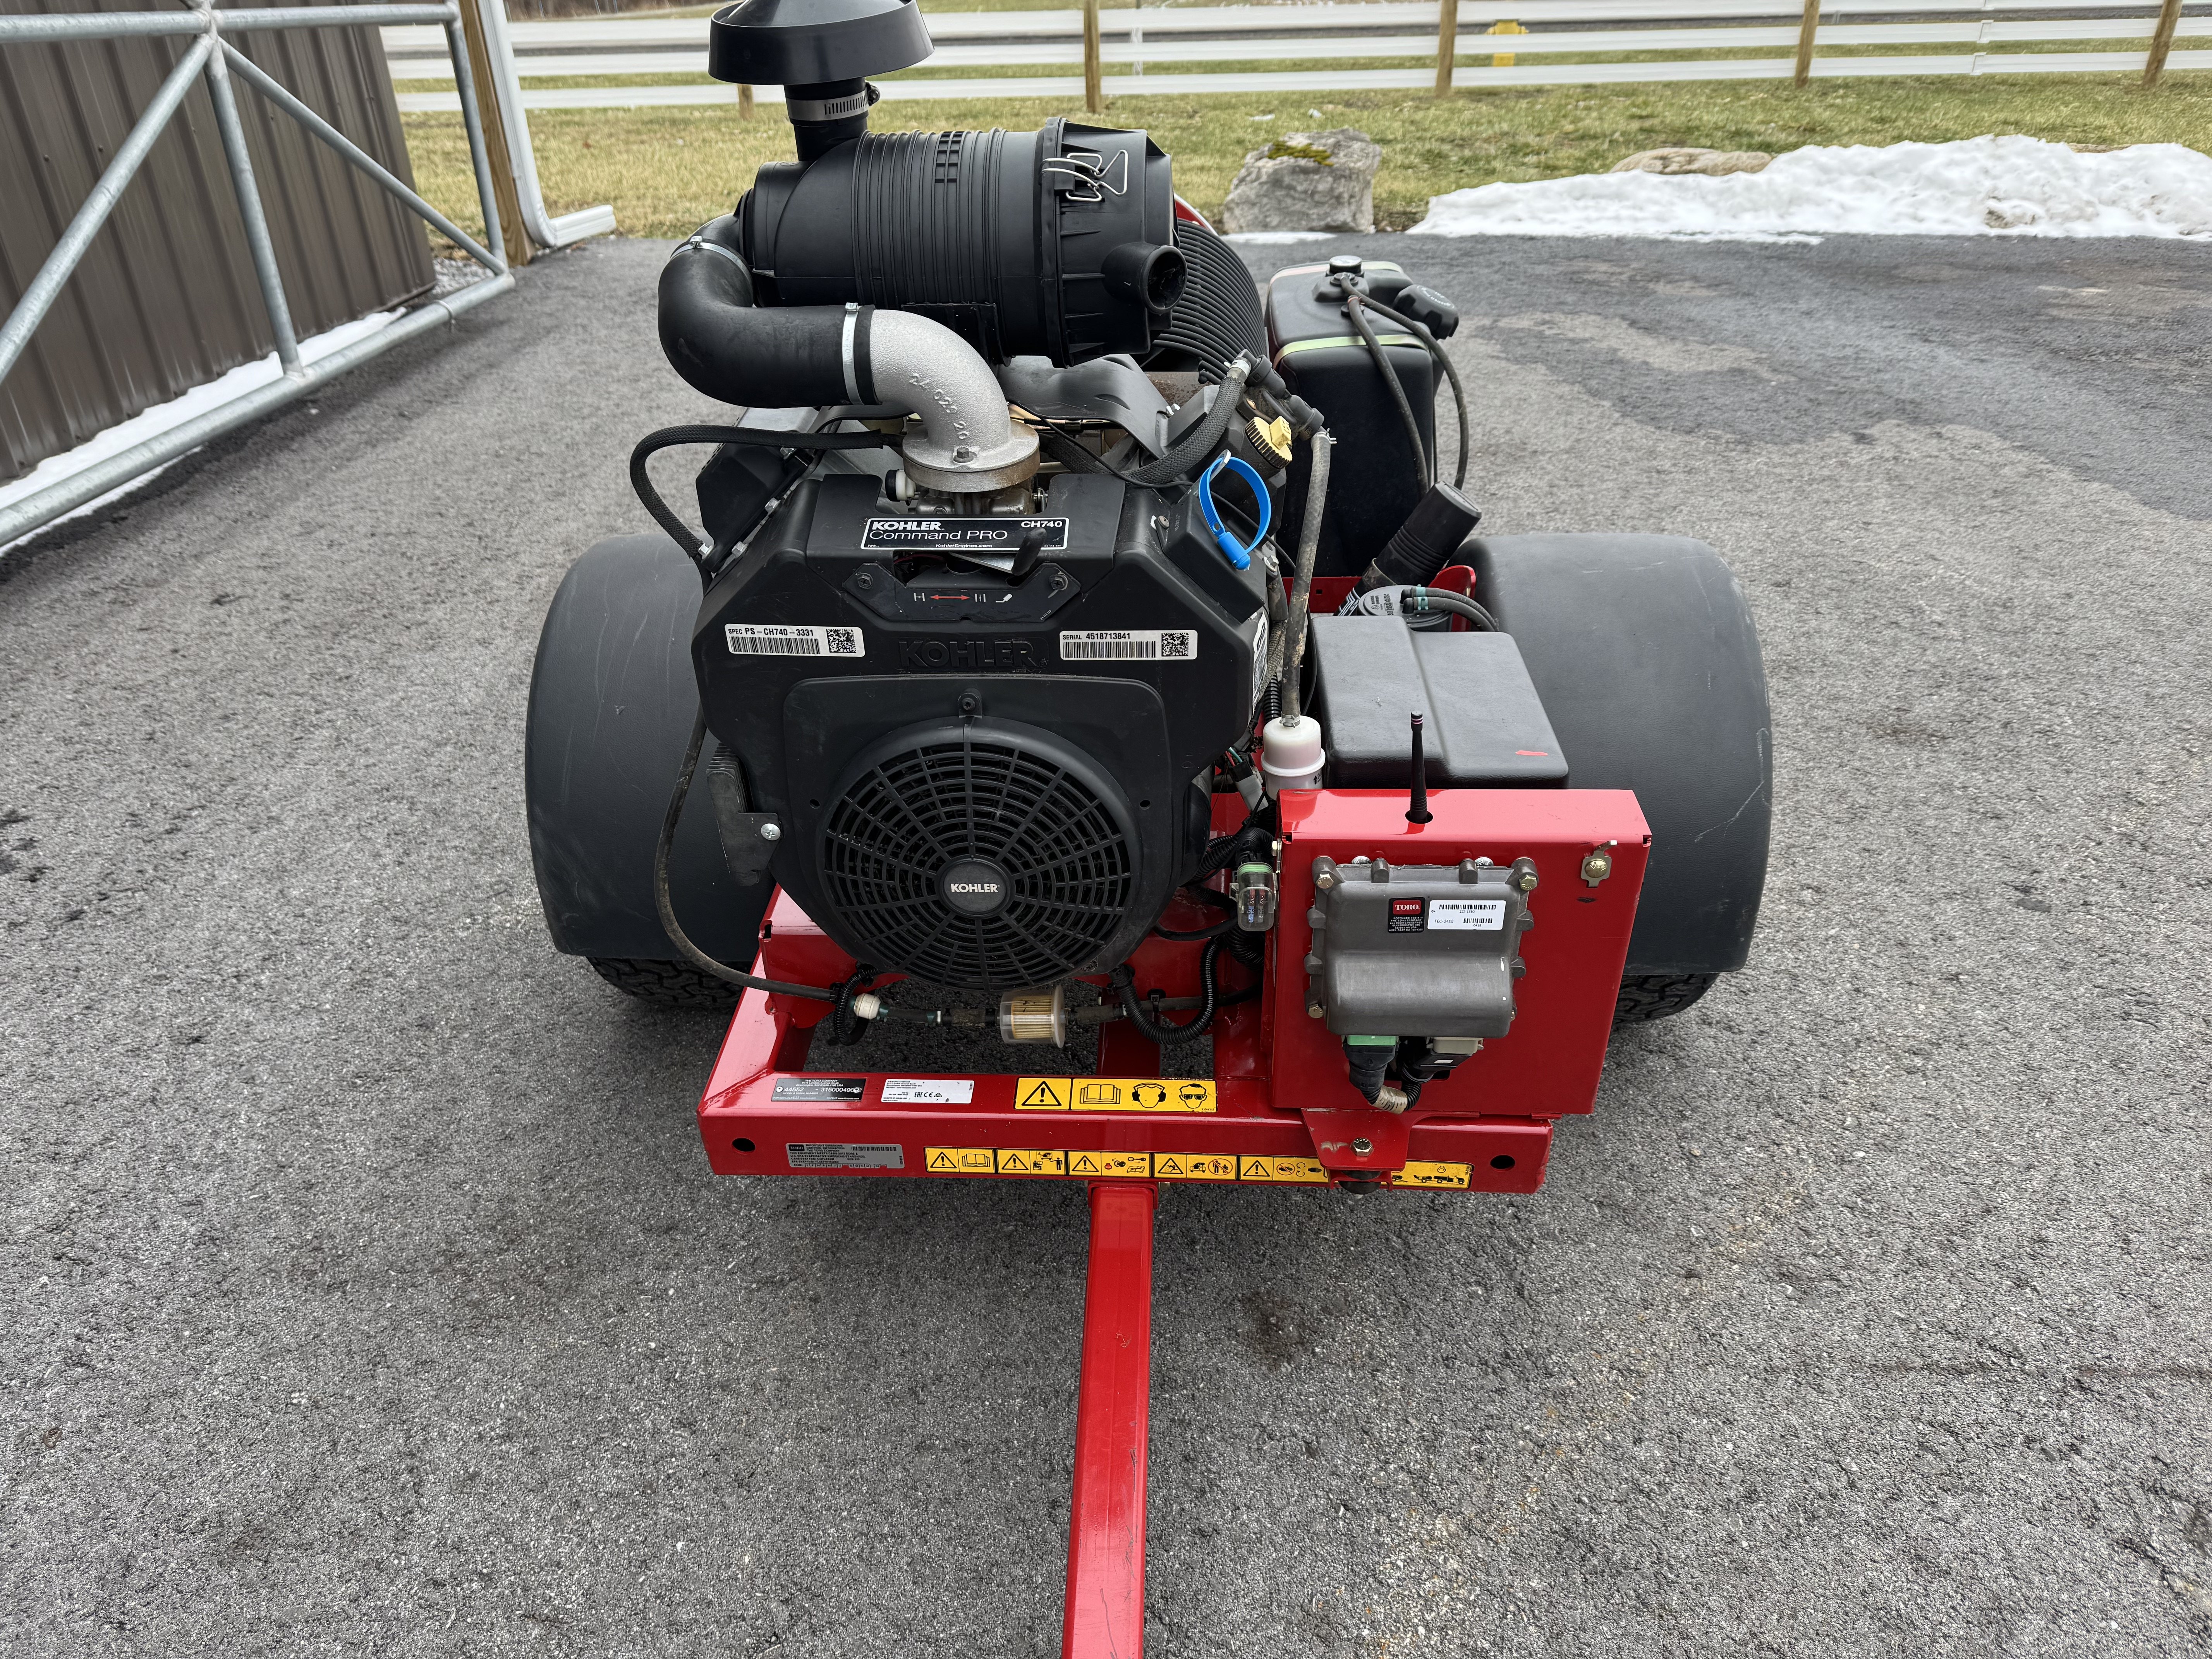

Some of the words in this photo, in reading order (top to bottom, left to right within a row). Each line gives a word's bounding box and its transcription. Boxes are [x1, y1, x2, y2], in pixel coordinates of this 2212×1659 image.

[872, 522, 944, 531] KOHLER
[869, 531, 962, 540] Command
[967, 531, 1008, 539] PRO
[899, 641, 1039, 667] KOHLER
[951, 883, 999, 893] KOHLER
